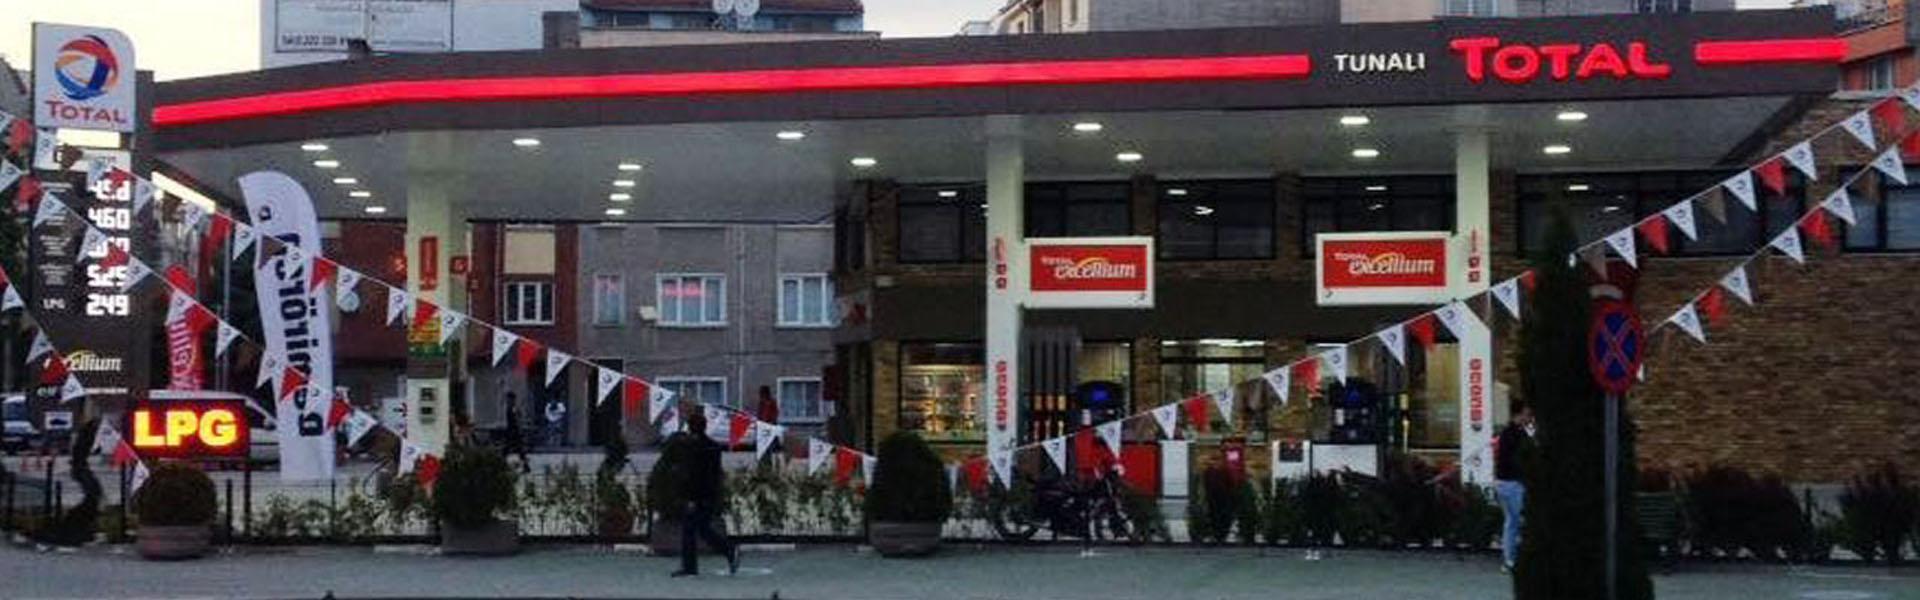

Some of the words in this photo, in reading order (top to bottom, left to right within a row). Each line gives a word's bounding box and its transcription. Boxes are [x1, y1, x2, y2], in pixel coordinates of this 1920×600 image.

[1334, 52, 1427, 73] TUNALI
[1450, 36, 1672, 82] TOTAL
[45, 100, 127, 124] TOTAL
[88, 207, 131, 230] 460
[1055, 259, 1137, 279] excellium
[1349, 253, 1435, 276] excellium
[43, 298, 66, 310] LPG
[87, 293, 129, 316] 249
[133, 409, 238, 447] LPG
